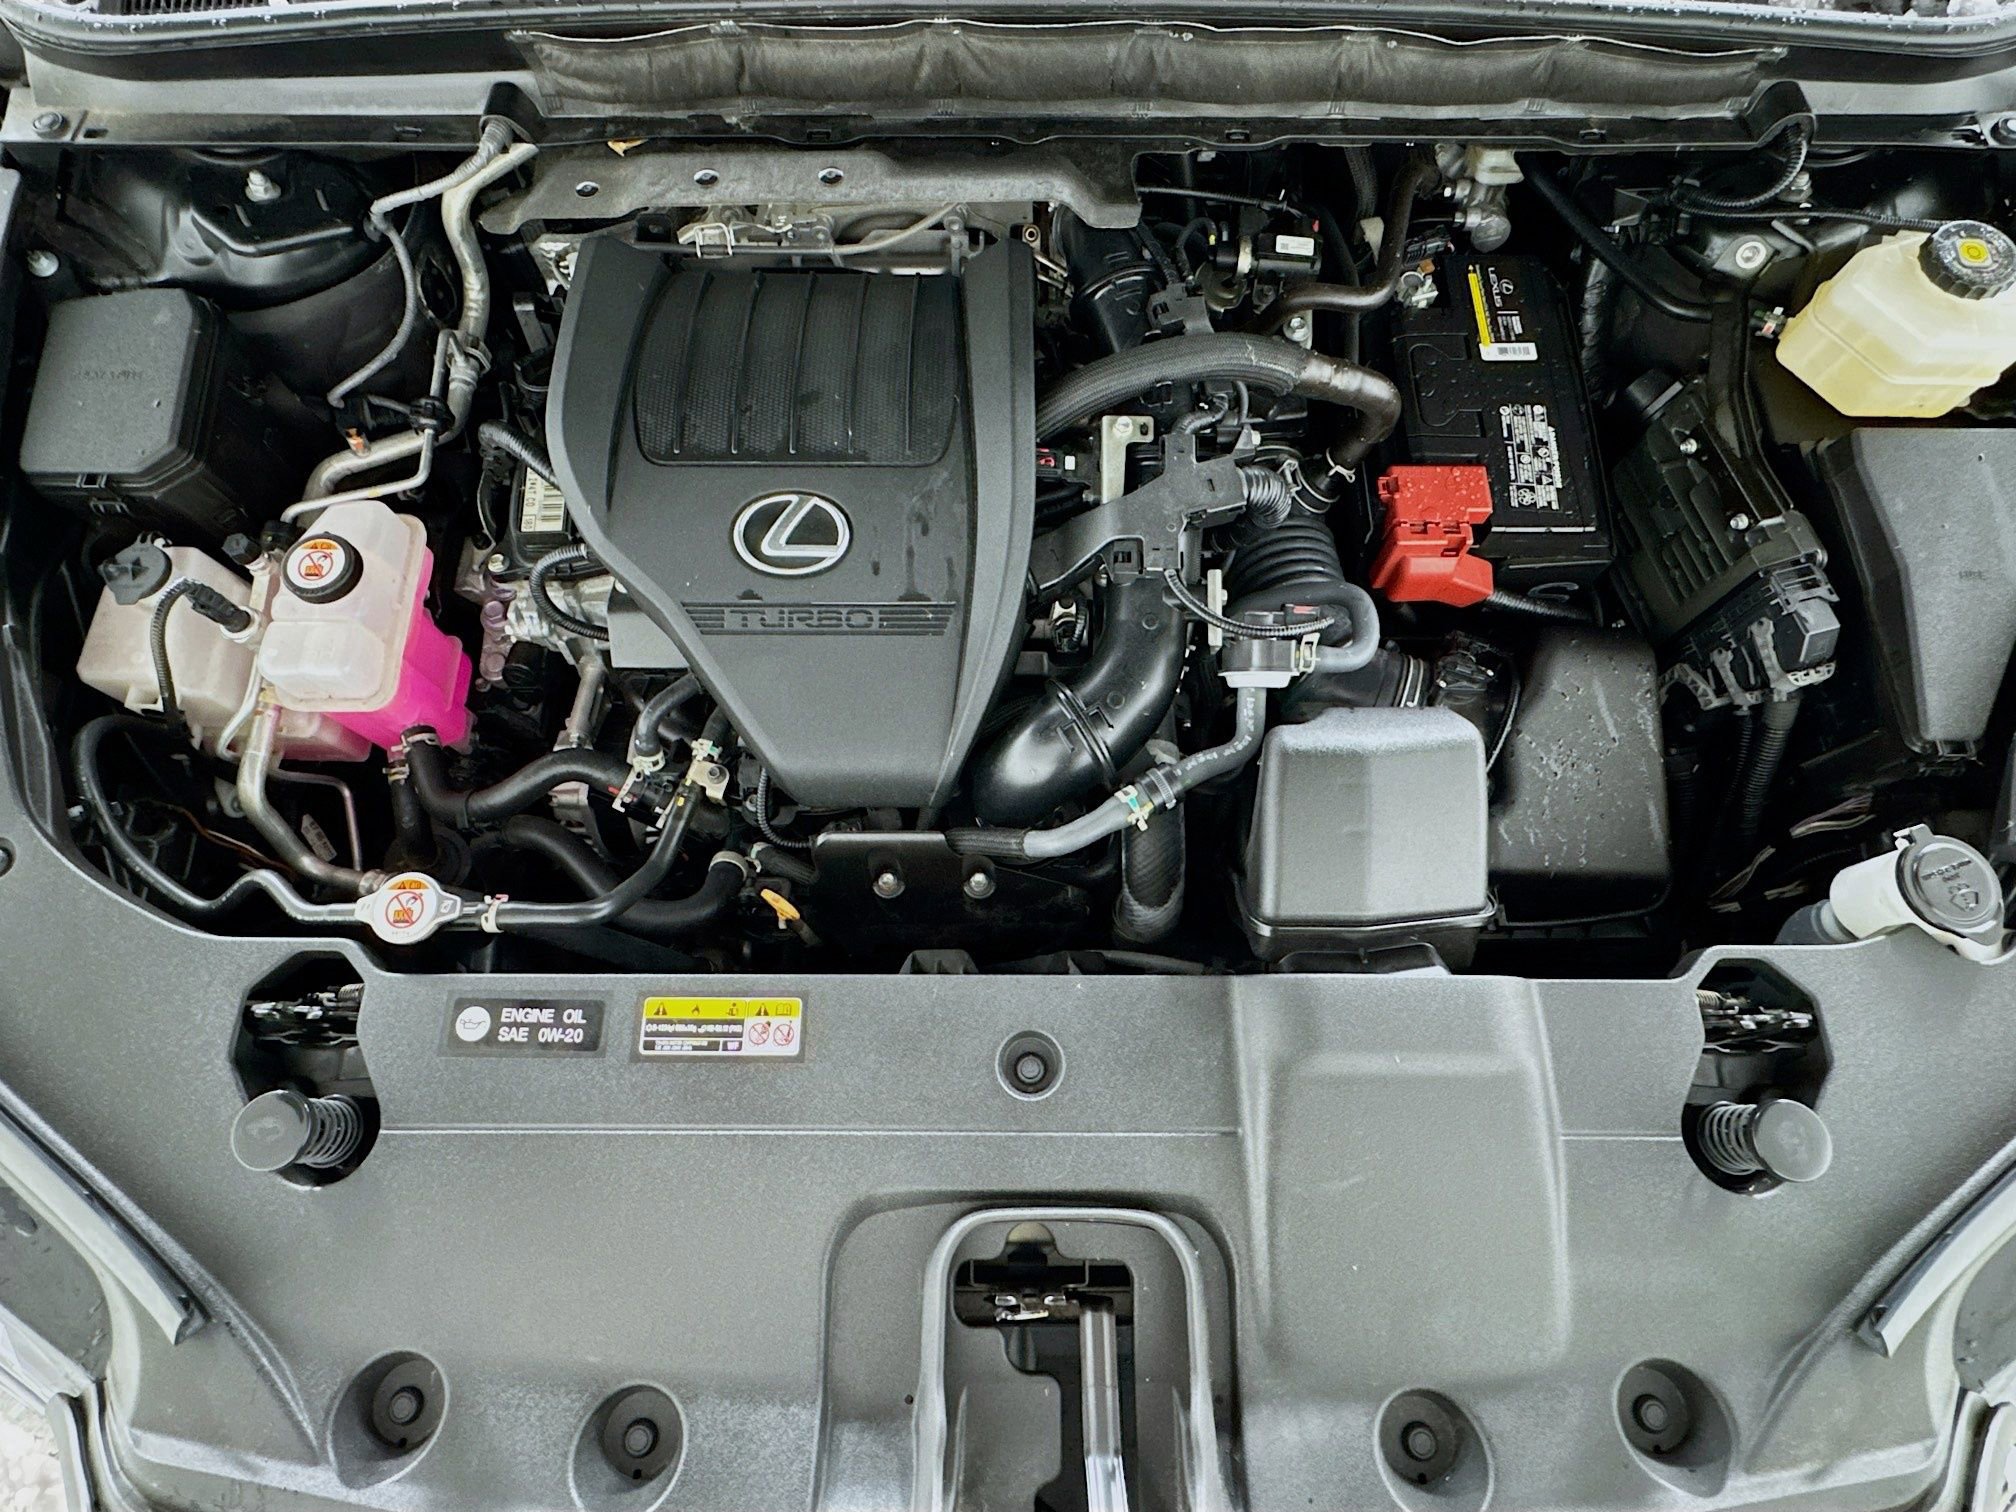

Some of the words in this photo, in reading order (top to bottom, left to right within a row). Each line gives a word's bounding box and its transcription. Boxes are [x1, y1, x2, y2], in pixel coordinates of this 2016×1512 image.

[1488, 267, 1503, 307] LEXUS
[730, 608, 874, 629] TURBO
[500, 1007, 556, 1023] ENGINE
[562, 1008, 587, 1024] OIL
[497, 1026, 530, 1042] SAE
[537, 1027, 584, 1044] 0W-20
